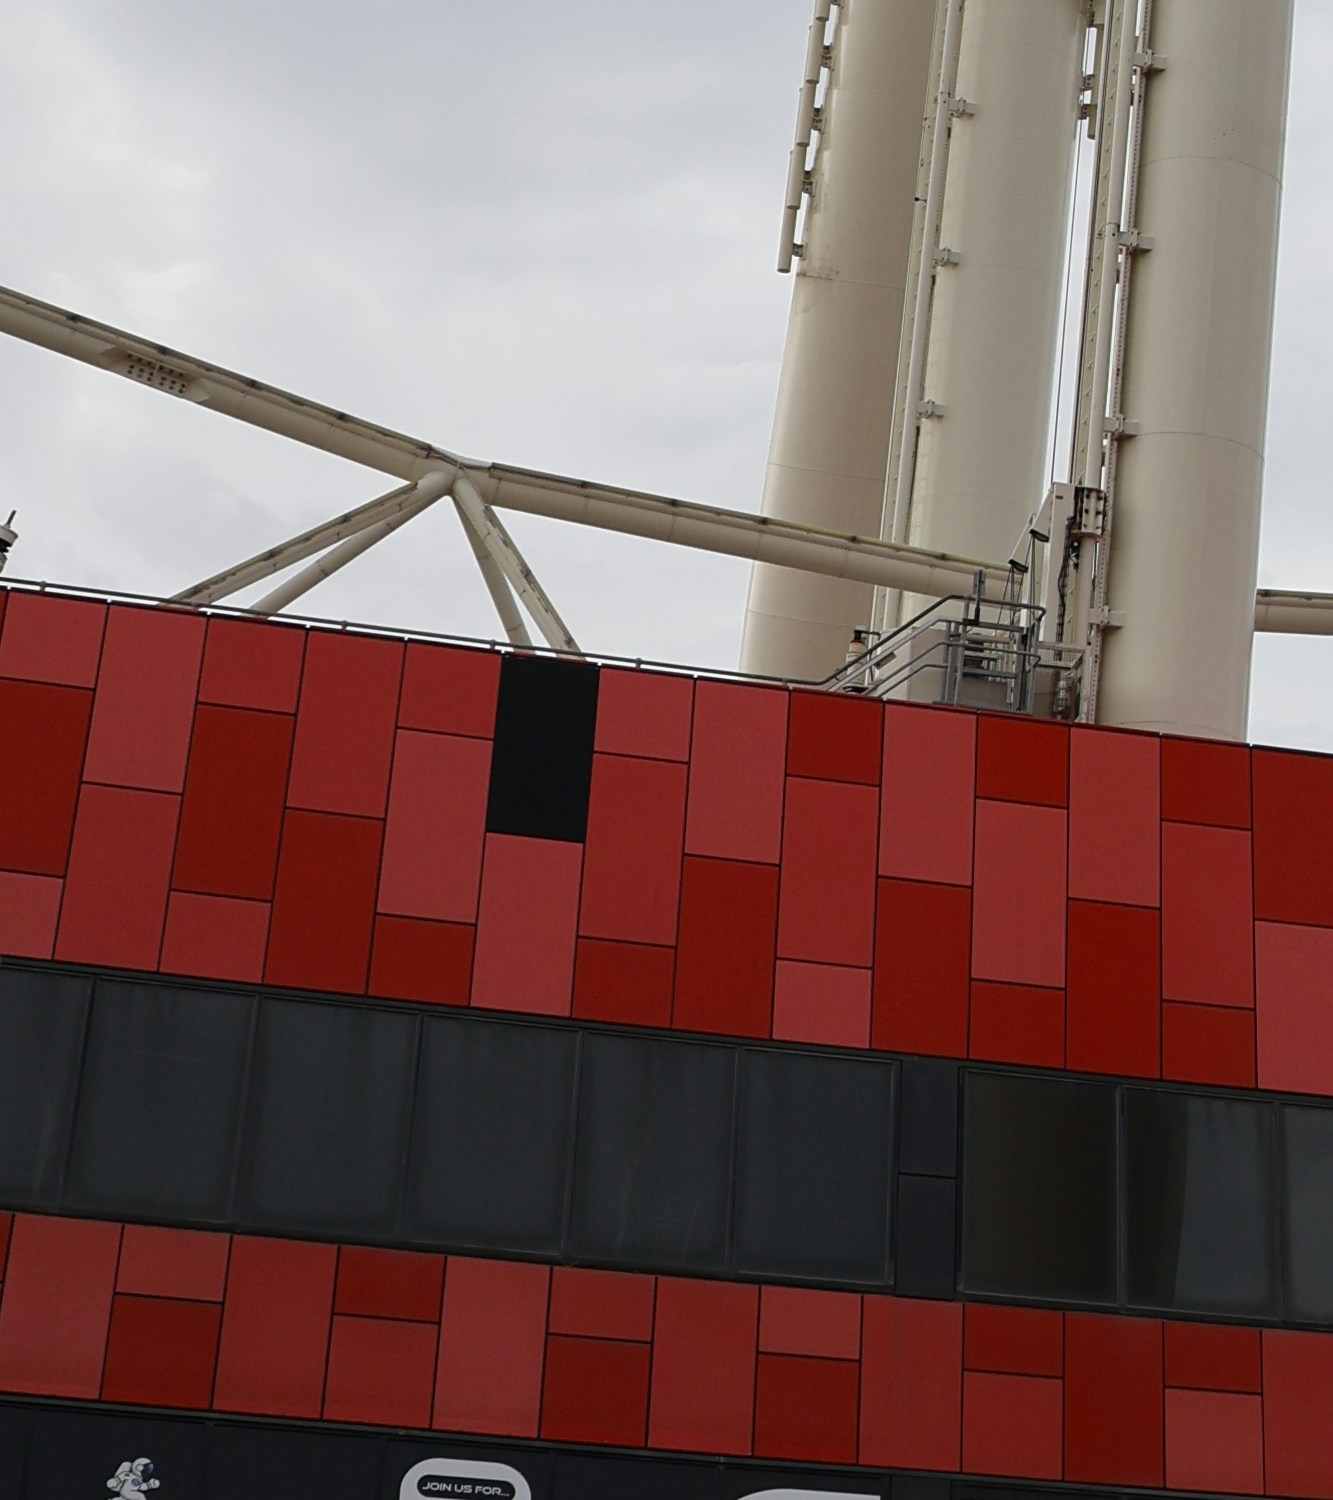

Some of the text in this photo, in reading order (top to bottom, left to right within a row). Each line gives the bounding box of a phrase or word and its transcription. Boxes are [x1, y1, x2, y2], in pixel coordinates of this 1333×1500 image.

[421, 1481, 511, 1497] JOIN US FOR...
